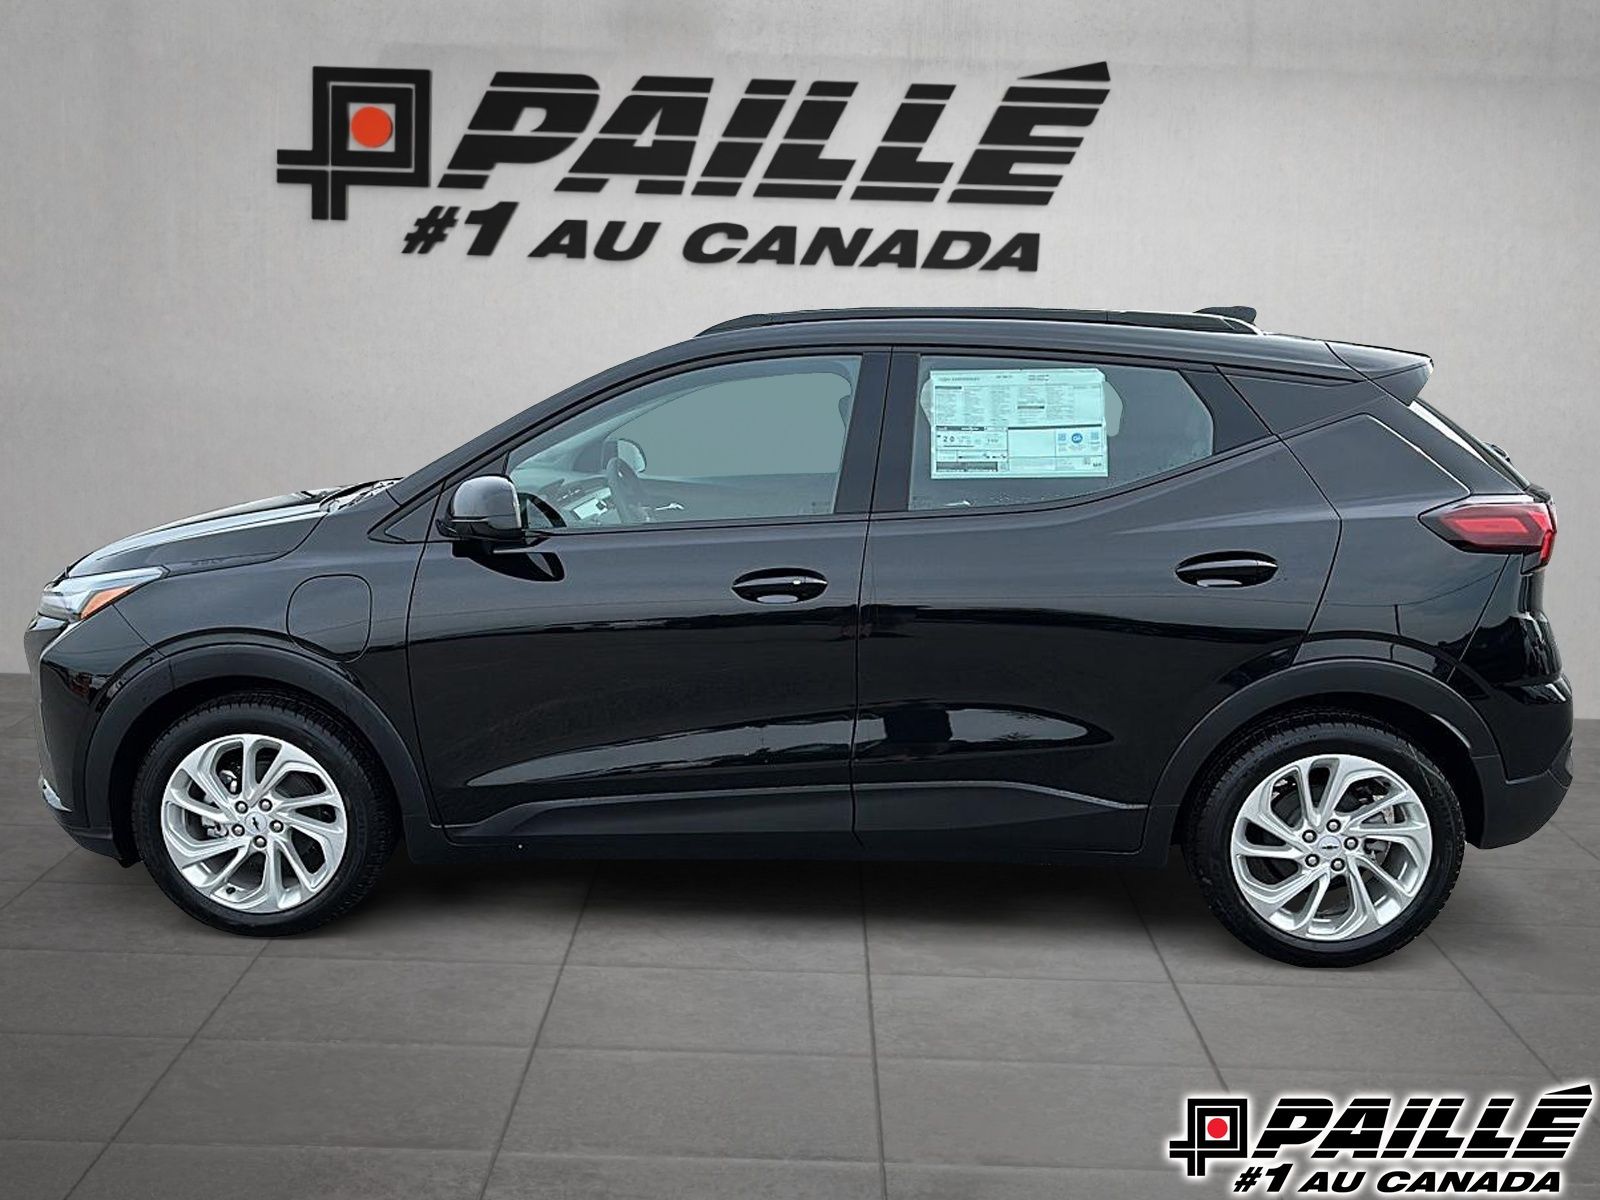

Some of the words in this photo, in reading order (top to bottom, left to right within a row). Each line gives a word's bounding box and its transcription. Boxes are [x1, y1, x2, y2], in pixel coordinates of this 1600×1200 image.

[437, 61, 1111, 206] PAILLÉ
[401, 201, 519, 257] #1
[527, 219, 662, 261] AU
[682, 222, 1041, 272] CANADA
